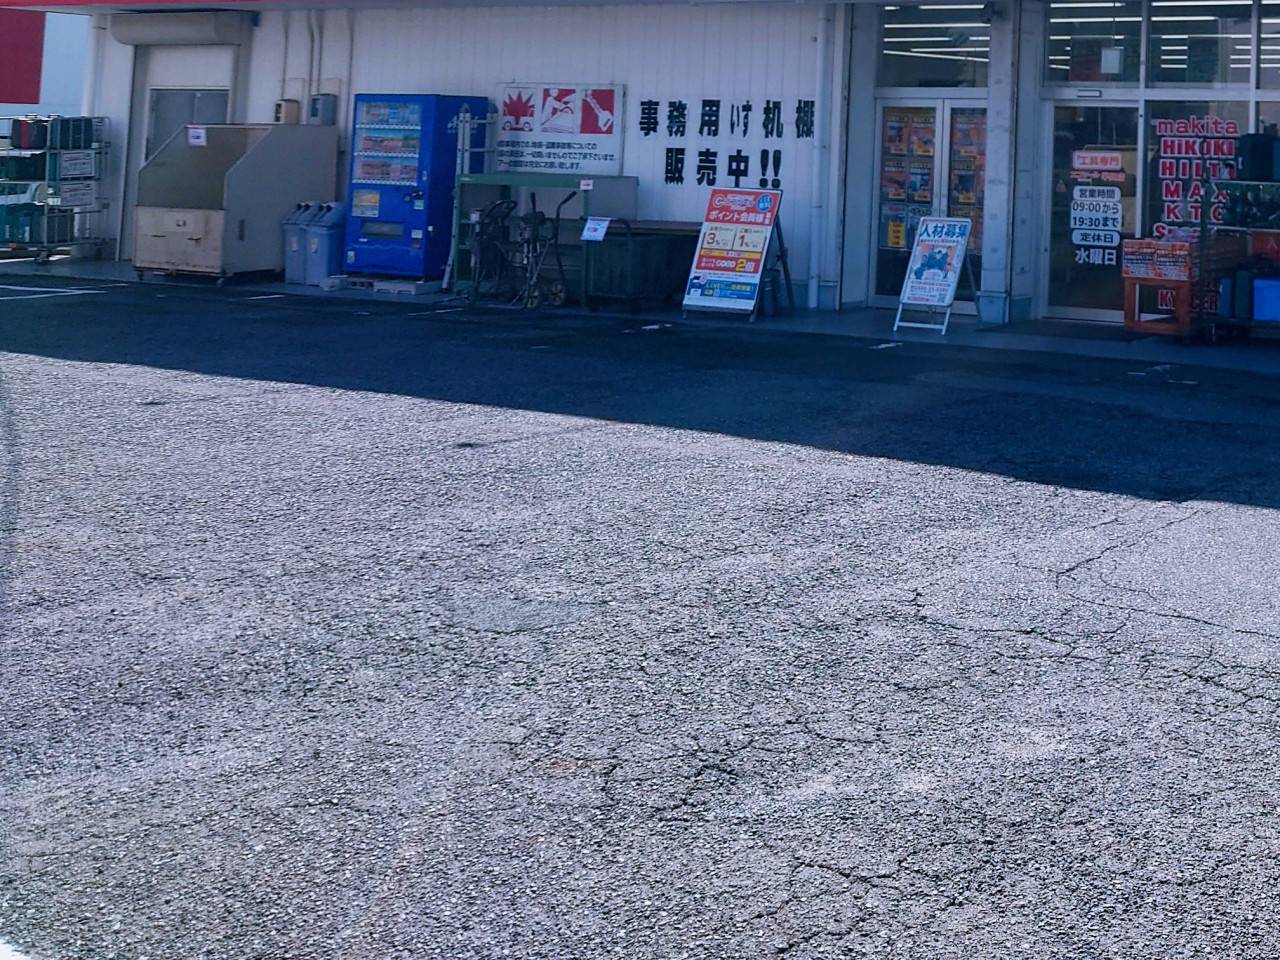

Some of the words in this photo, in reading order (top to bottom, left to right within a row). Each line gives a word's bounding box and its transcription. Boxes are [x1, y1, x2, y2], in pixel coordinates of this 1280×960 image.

[1156, 115, 1240, 136] makita
[1072, 201, 1119, 215] 09:00から
[1072, 216, 1119, 228] 19:30まで
[1080, 232, 1114, 244] 定休日
[1075, 248, 1117, 265] 水曜日
